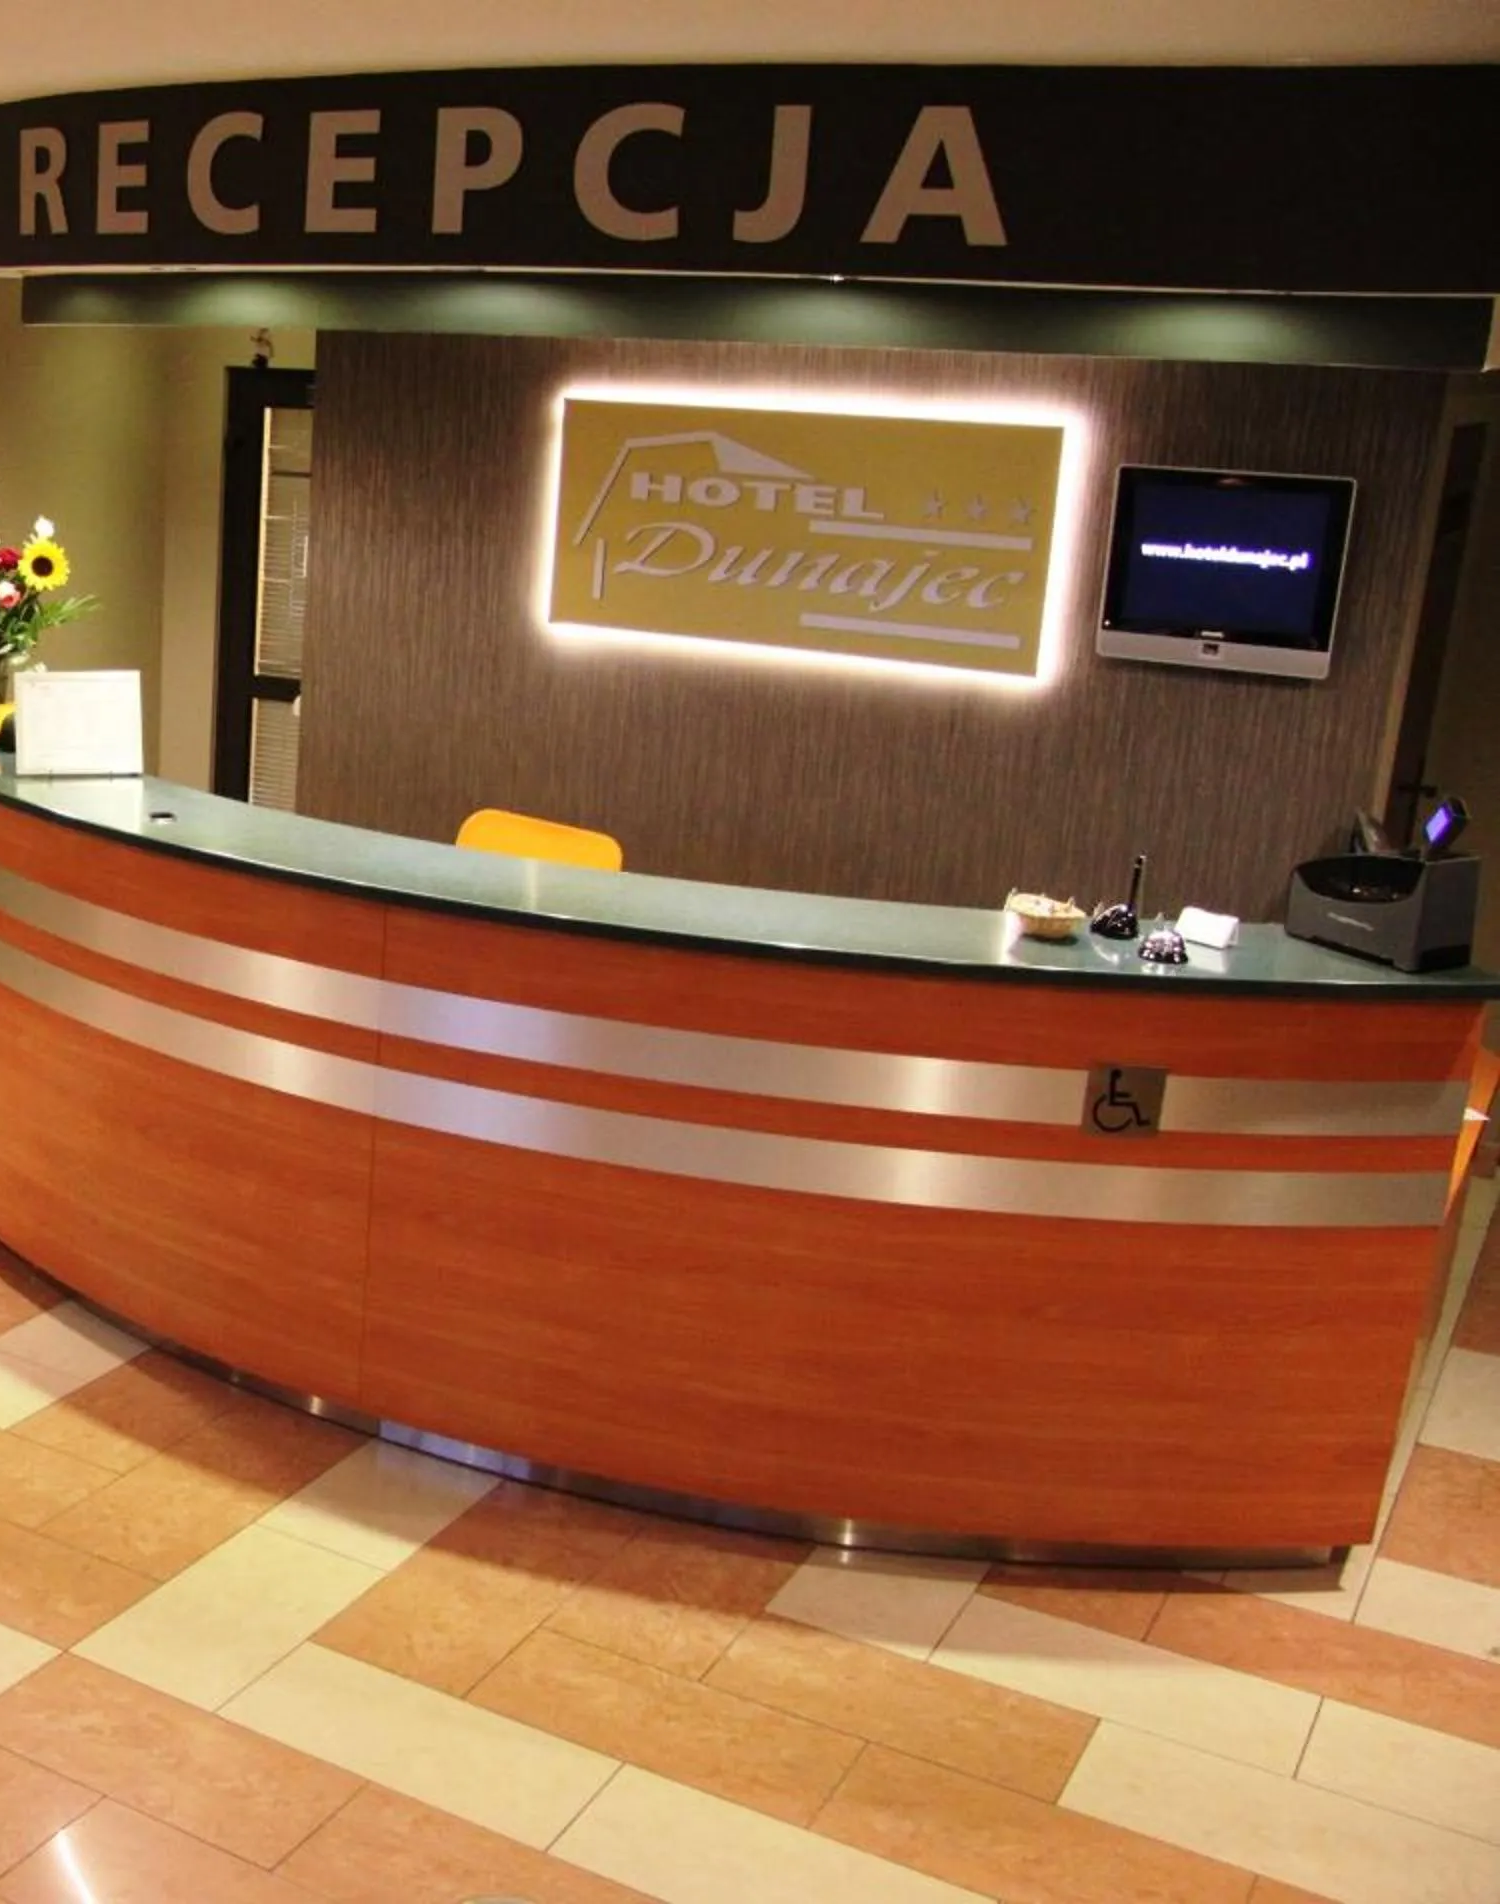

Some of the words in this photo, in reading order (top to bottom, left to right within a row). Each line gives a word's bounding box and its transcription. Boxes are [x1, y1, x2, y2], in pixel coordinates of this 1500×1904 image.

[19, 102, 1008, 246] RECEPCJA
[630, 471, 885, 521] HOTEL
[613, 521, 1026, 613] Dunajec
